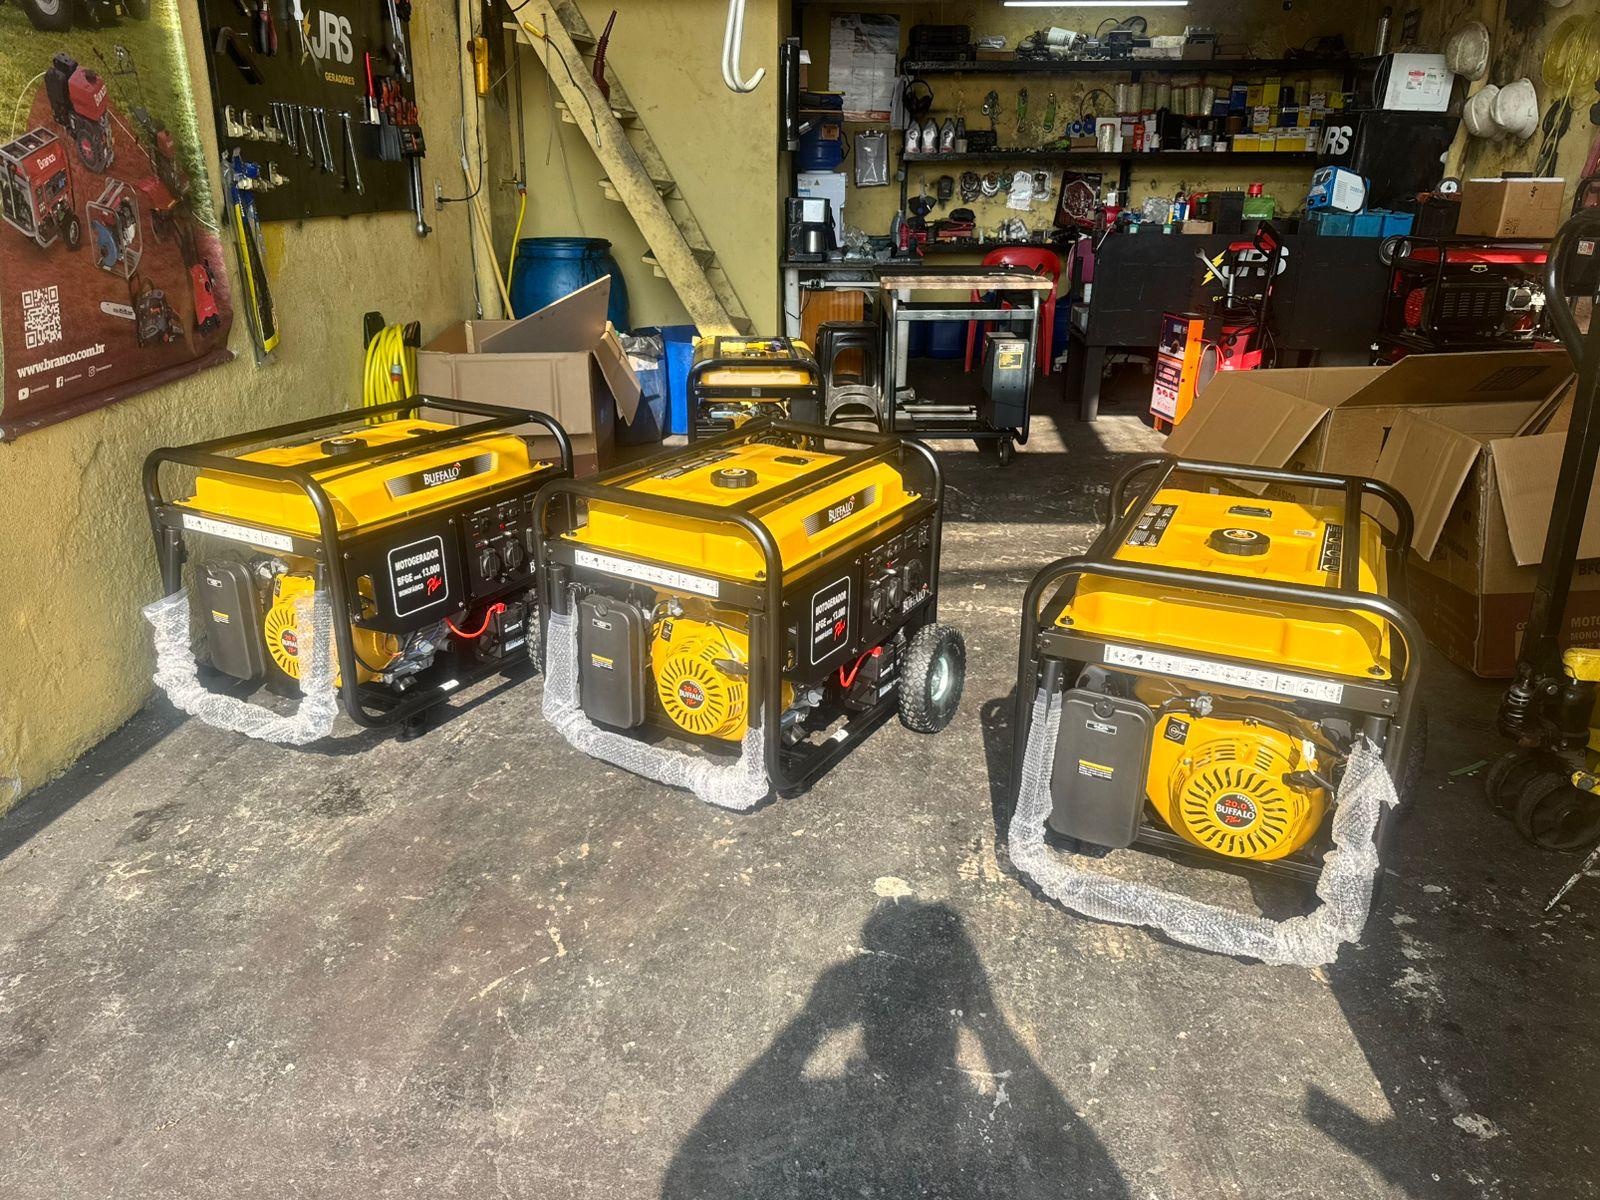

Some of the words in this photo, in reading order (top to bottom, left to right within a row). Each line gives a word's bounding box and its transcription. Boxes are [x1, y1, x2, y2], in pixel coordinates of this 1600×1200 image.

[311, 10, 353, 64] JRS
[324, 71, 355, 86] GERADORES
[16, 343, 106, 379] www.branco.com.br
[423, 467, 460, 485] BUFFALO
[828, 500, 854, 522] BUFFALO
[394, 548, 439, 572] MOTOGERADOR
[1215, 803, 1255, 820] BUFFALO
[1225, 799, 1248, 811] 20.0
